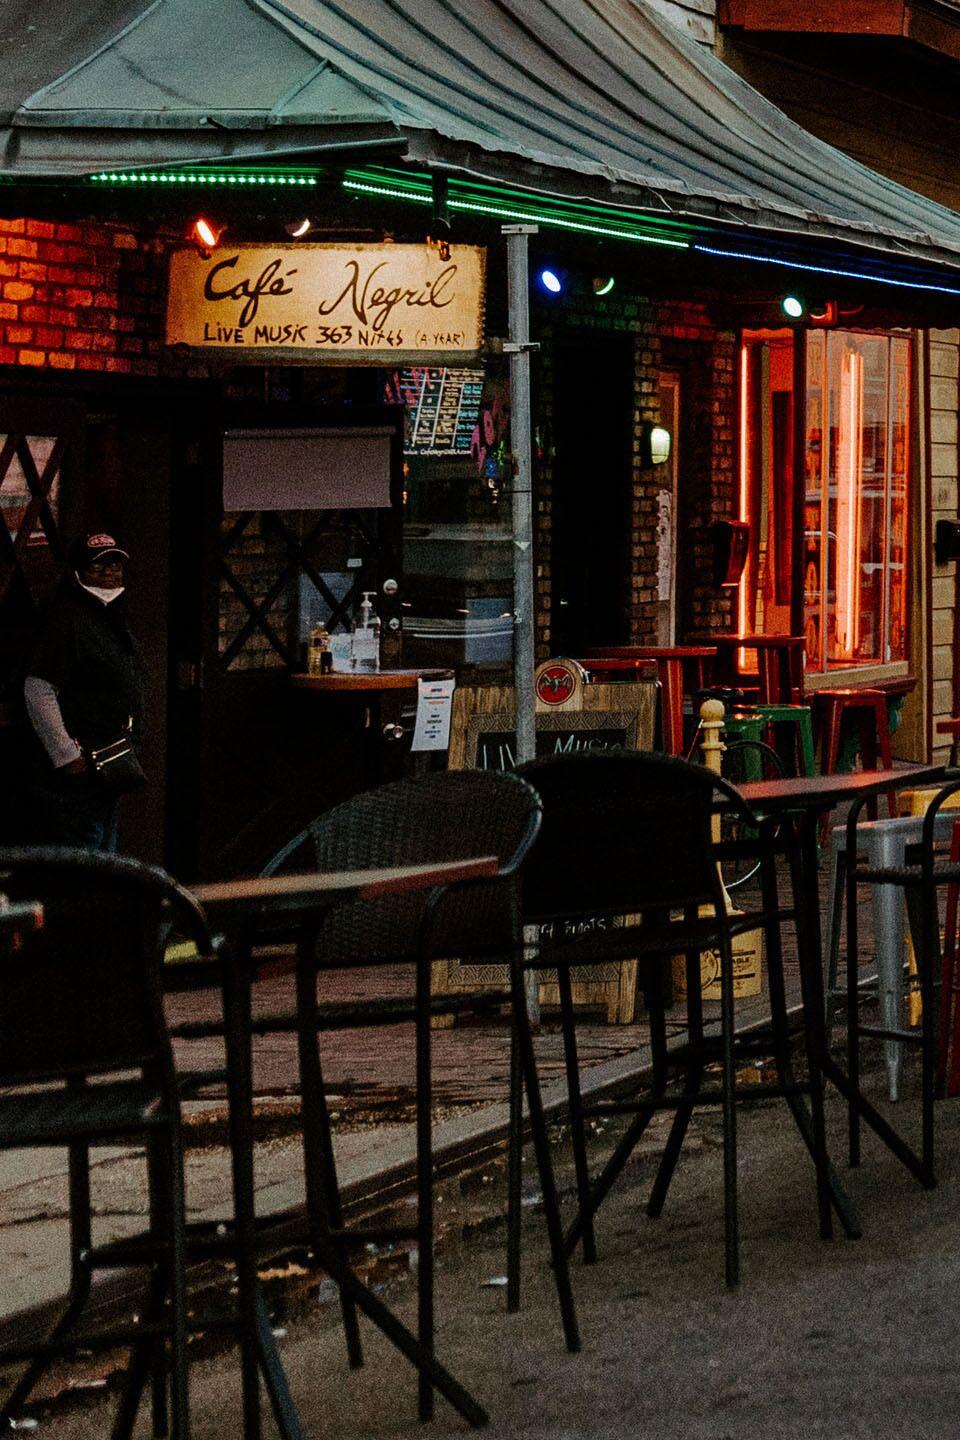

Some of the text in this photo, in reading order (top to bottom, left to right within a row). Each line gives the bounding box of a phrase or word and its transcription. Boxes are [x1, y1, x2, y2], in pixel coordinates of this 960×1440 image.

[204, 255, 458, 331] Café Negril
[315, 325, 353, 344] 363
